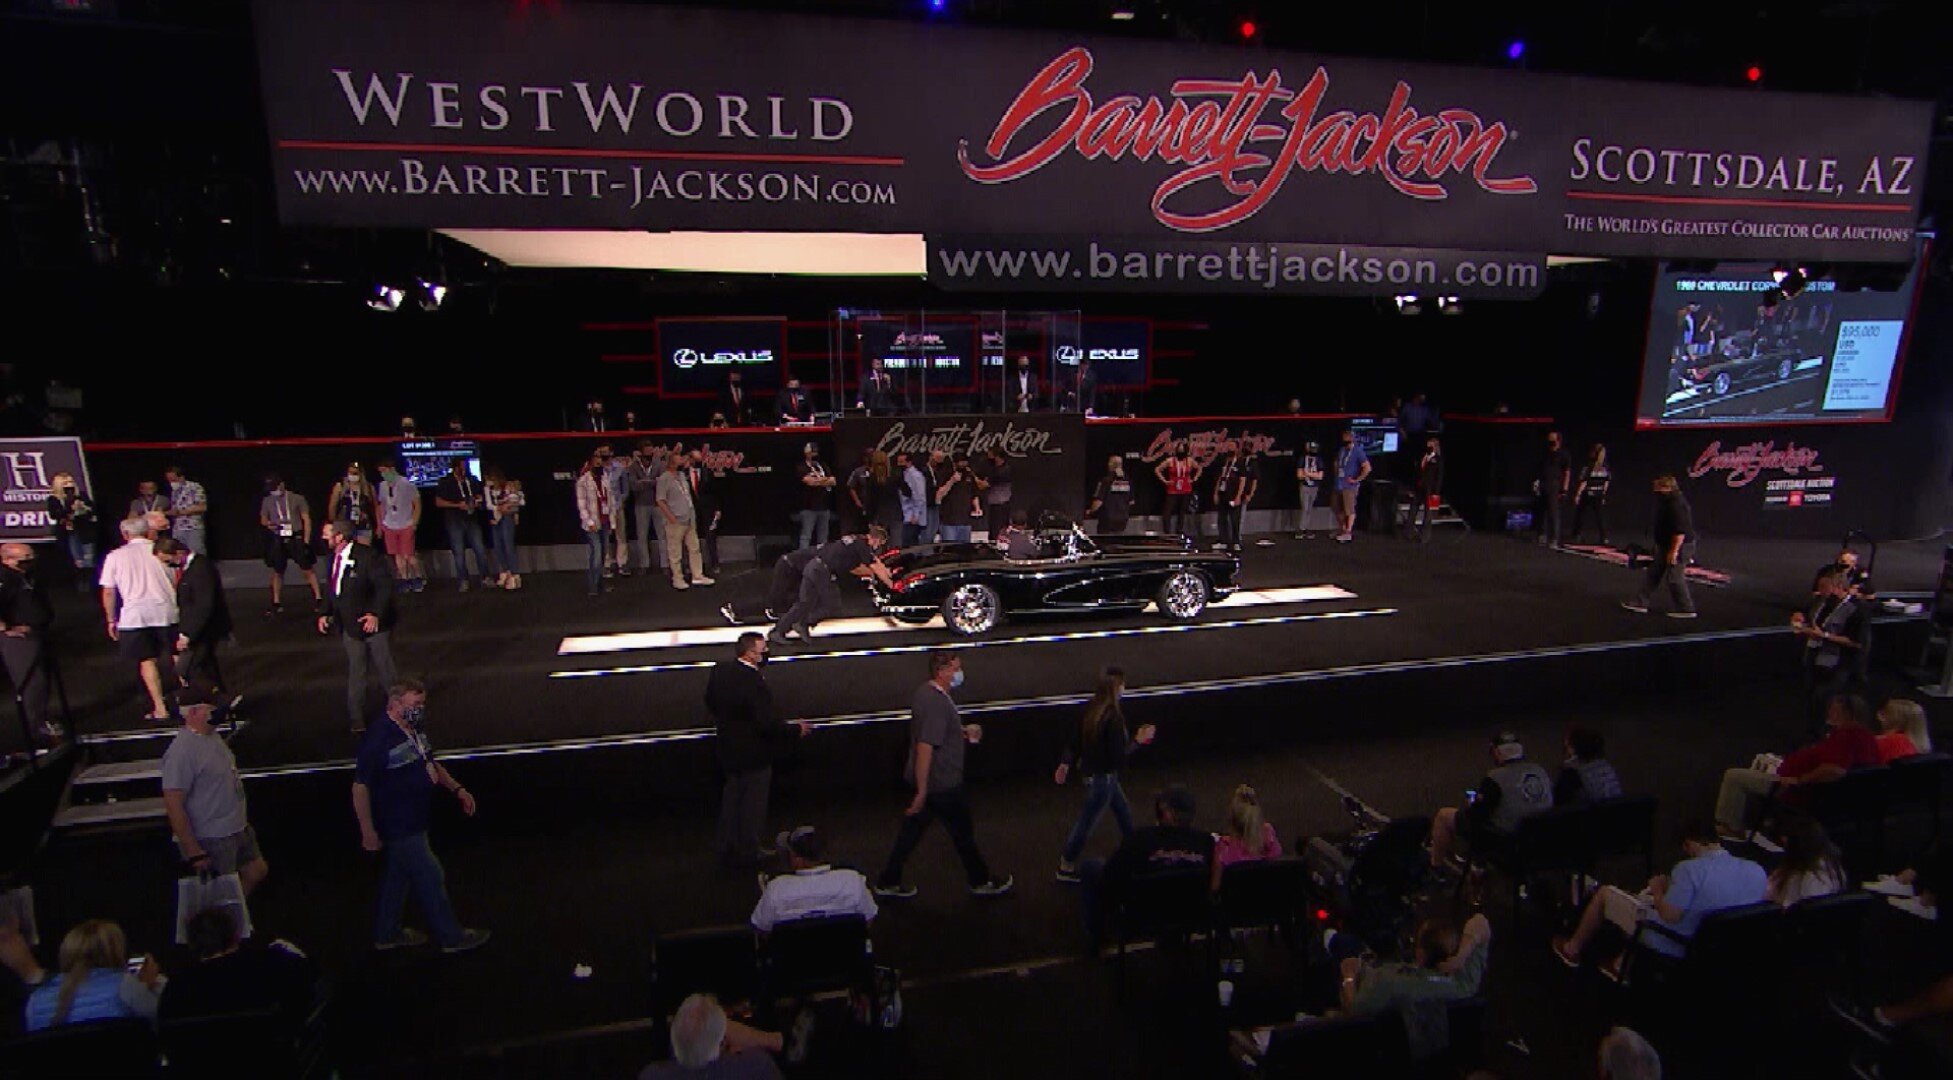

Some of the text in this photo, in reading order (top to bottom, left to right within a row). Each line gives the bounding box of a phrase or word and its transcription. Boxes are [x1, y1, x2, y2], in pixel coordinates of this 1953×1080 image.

[331, 69, 853, 141] WESTWORLD
[959, 46, 1537, 232] Barrett-Jackson
[1570, 138, 1915, 198] SCOTTSDALE, AZ
[1565, 213, 1594, 232] THE
[1661, 219, 1729, 235] GREATEST
[1731, 220, 1809, 239] COLLECTOR
[1811, 223, 1839, 240] CAR
[939, 243, 1537, 288] www.barrett-jackson.com
[700, 350, 774, 364] LEXUS
[877, 421, 1062, 458] Barrett-Jackson
[5, 511, 57, 527] DRIV
